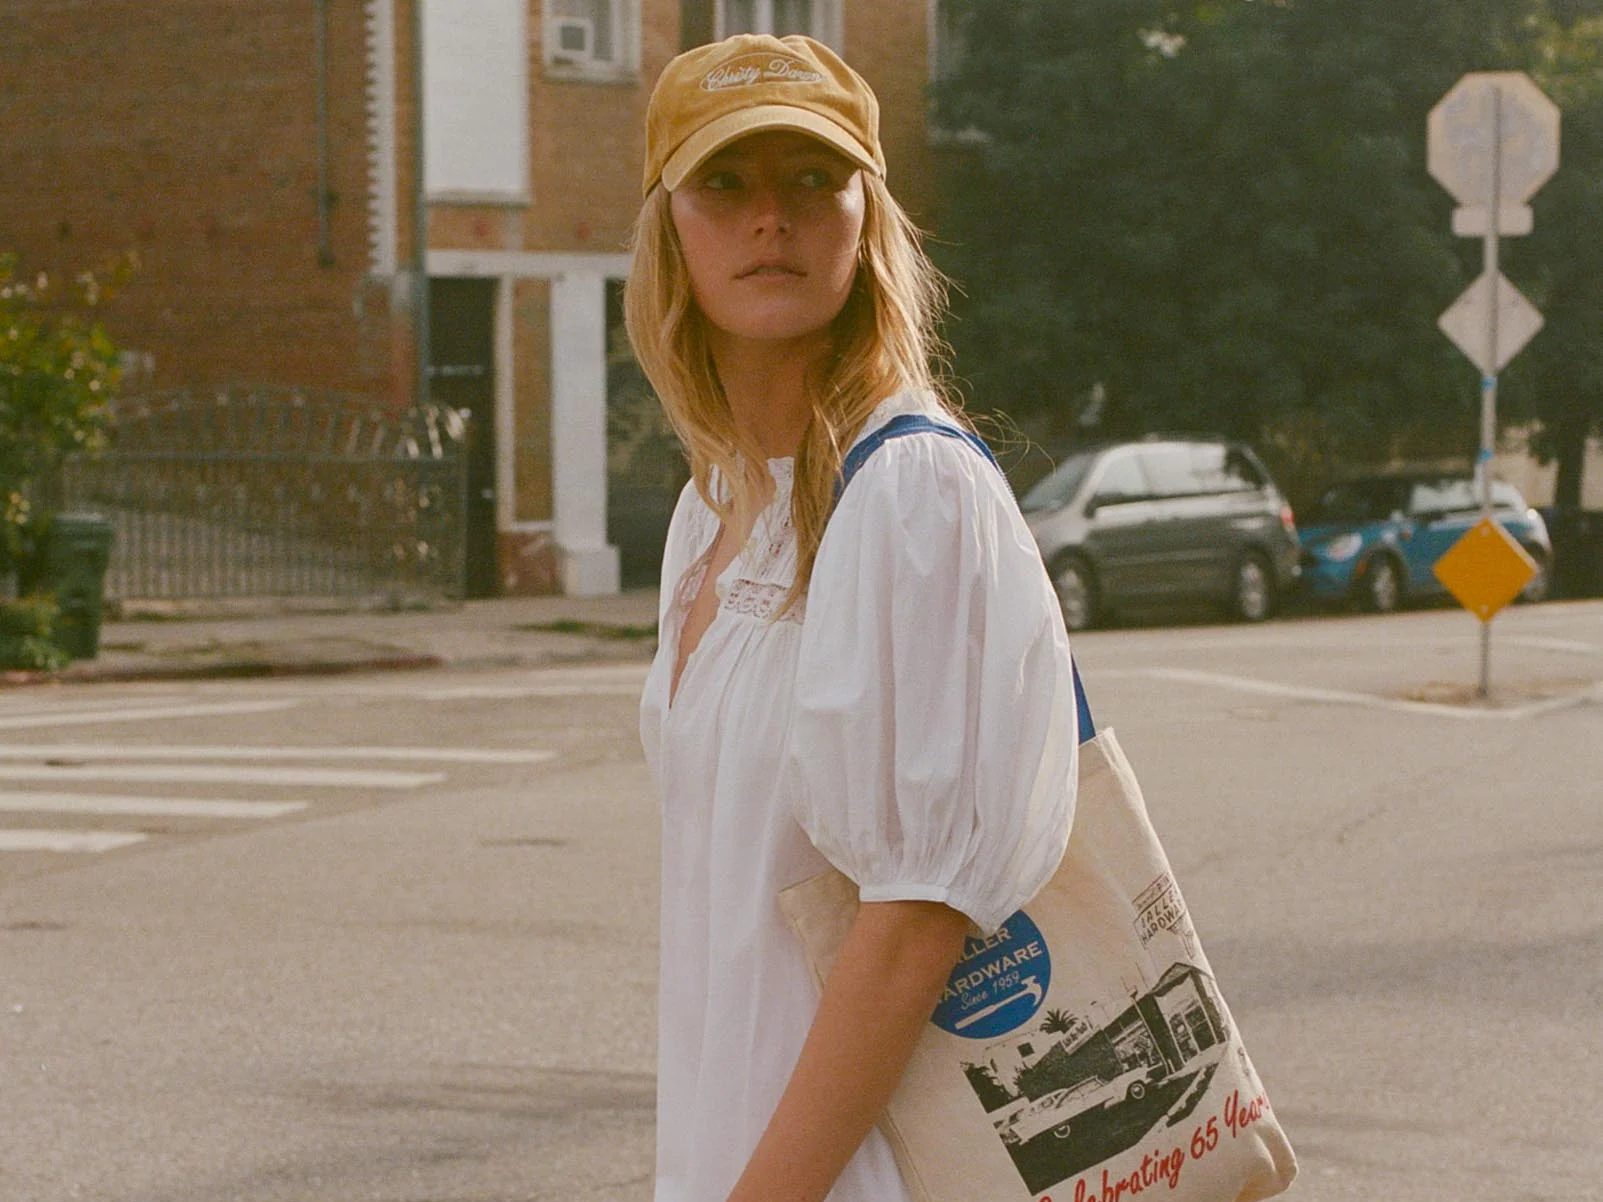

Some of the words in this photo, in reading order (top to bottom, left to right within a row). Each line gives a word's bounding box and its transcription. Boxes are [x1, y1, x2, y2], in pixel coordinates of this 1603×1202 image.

[959, 927, 1013, 964] LLER
[940, 941, 1043, 1004] ARDWARE
[961, 990, 988, 1010] Since
[992, 970, 1021, 993] 1959
[1190, 1115, 1220, 1160] 65
[1224, 1088, 1269, 1138] Year
